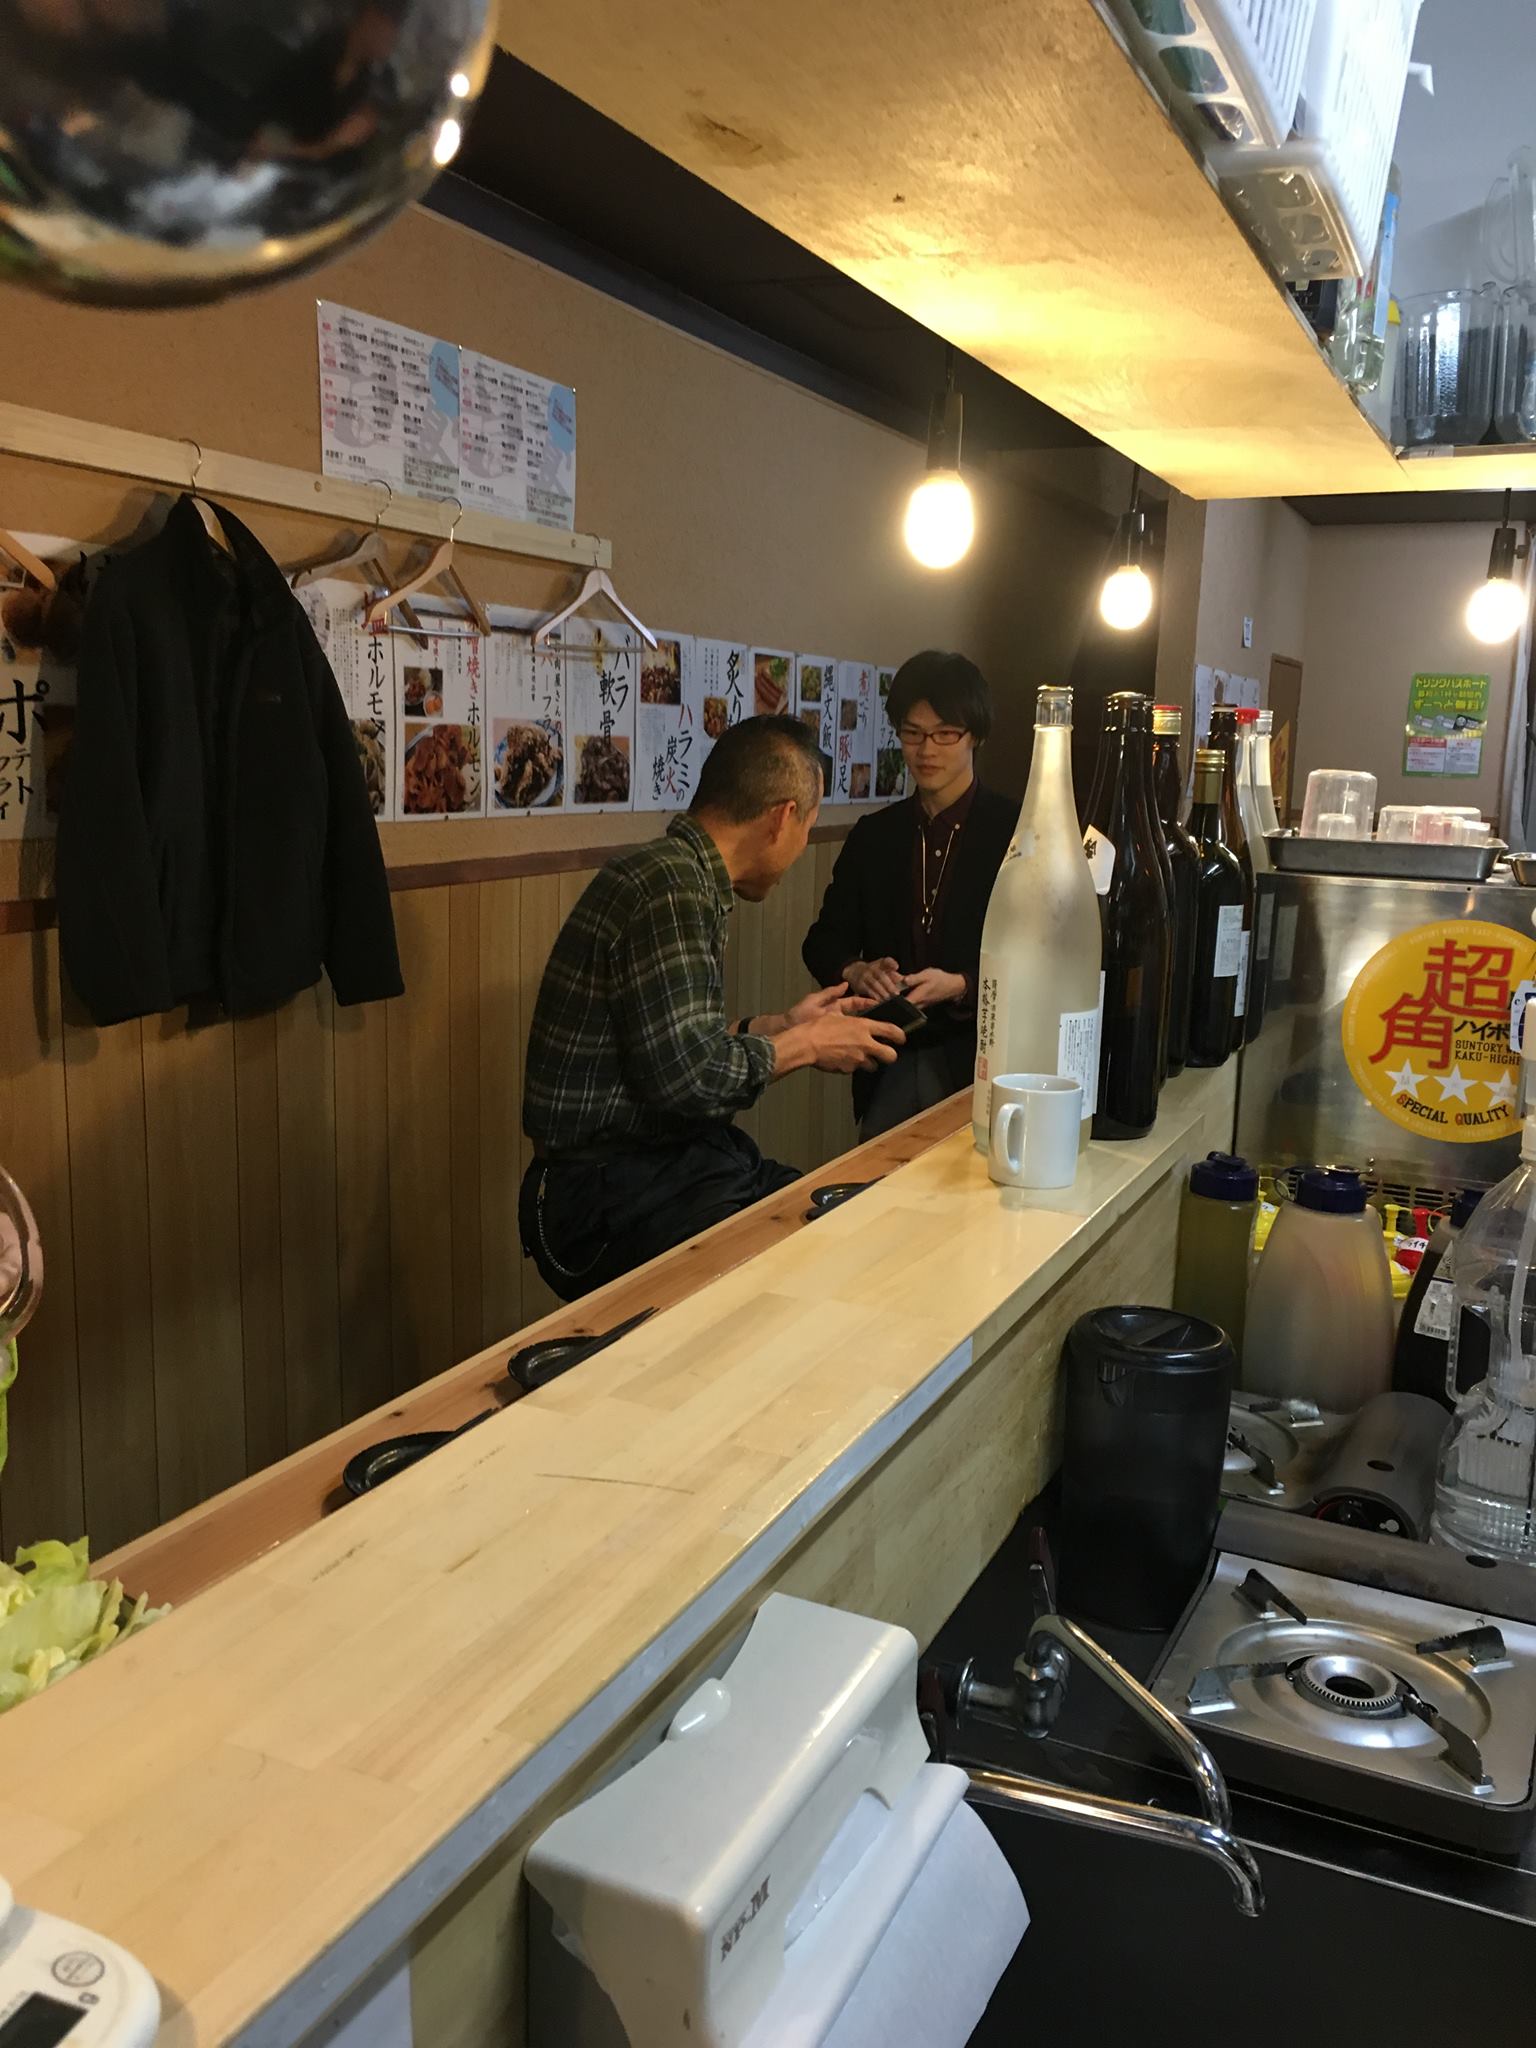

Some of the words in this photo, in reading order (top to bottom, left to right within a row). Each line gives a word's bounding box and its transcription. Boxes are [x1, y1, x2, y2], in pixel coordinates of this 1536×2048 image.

[614, 634, 631, 713] バラ
[599, 669, 617, 747] 軟骨
[664, 735, 679, 794] 炭火
[675, 703, 693, 802] ハラミの
[652, 754, 666, 801] 焼き
[1454, 1020, 1510, 1041] ハイボ
[1455, 1039, 1504, 1053] SUNTORY
[1396, 1094, 1449, 1125] SPECIAL
[1455, 1105, 1510, 1126] QUALITY
